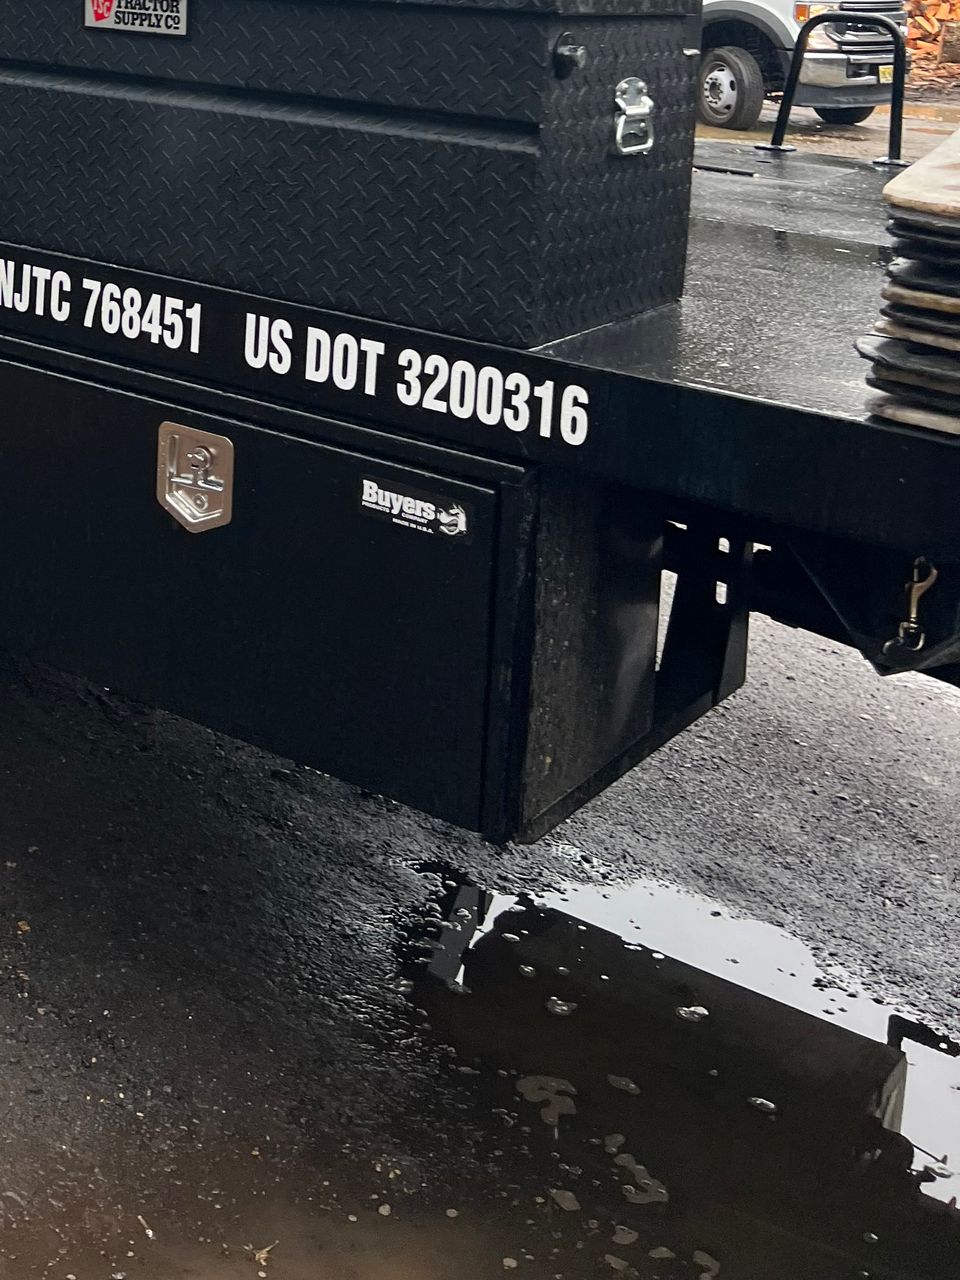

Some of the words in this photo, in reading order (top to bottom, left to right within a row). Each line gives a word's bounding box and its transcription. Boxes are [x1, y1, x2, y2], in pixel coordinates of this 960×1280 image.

[114, 10, 163, 29] SUPPLY
[81, 276, 202, 355] 768451
[243, 312, 293, 376] US
[304, 326, 385, 397] DOT
[396, 348, 589, 446] 3200316
[361, 479, 436, 521] Buyers
